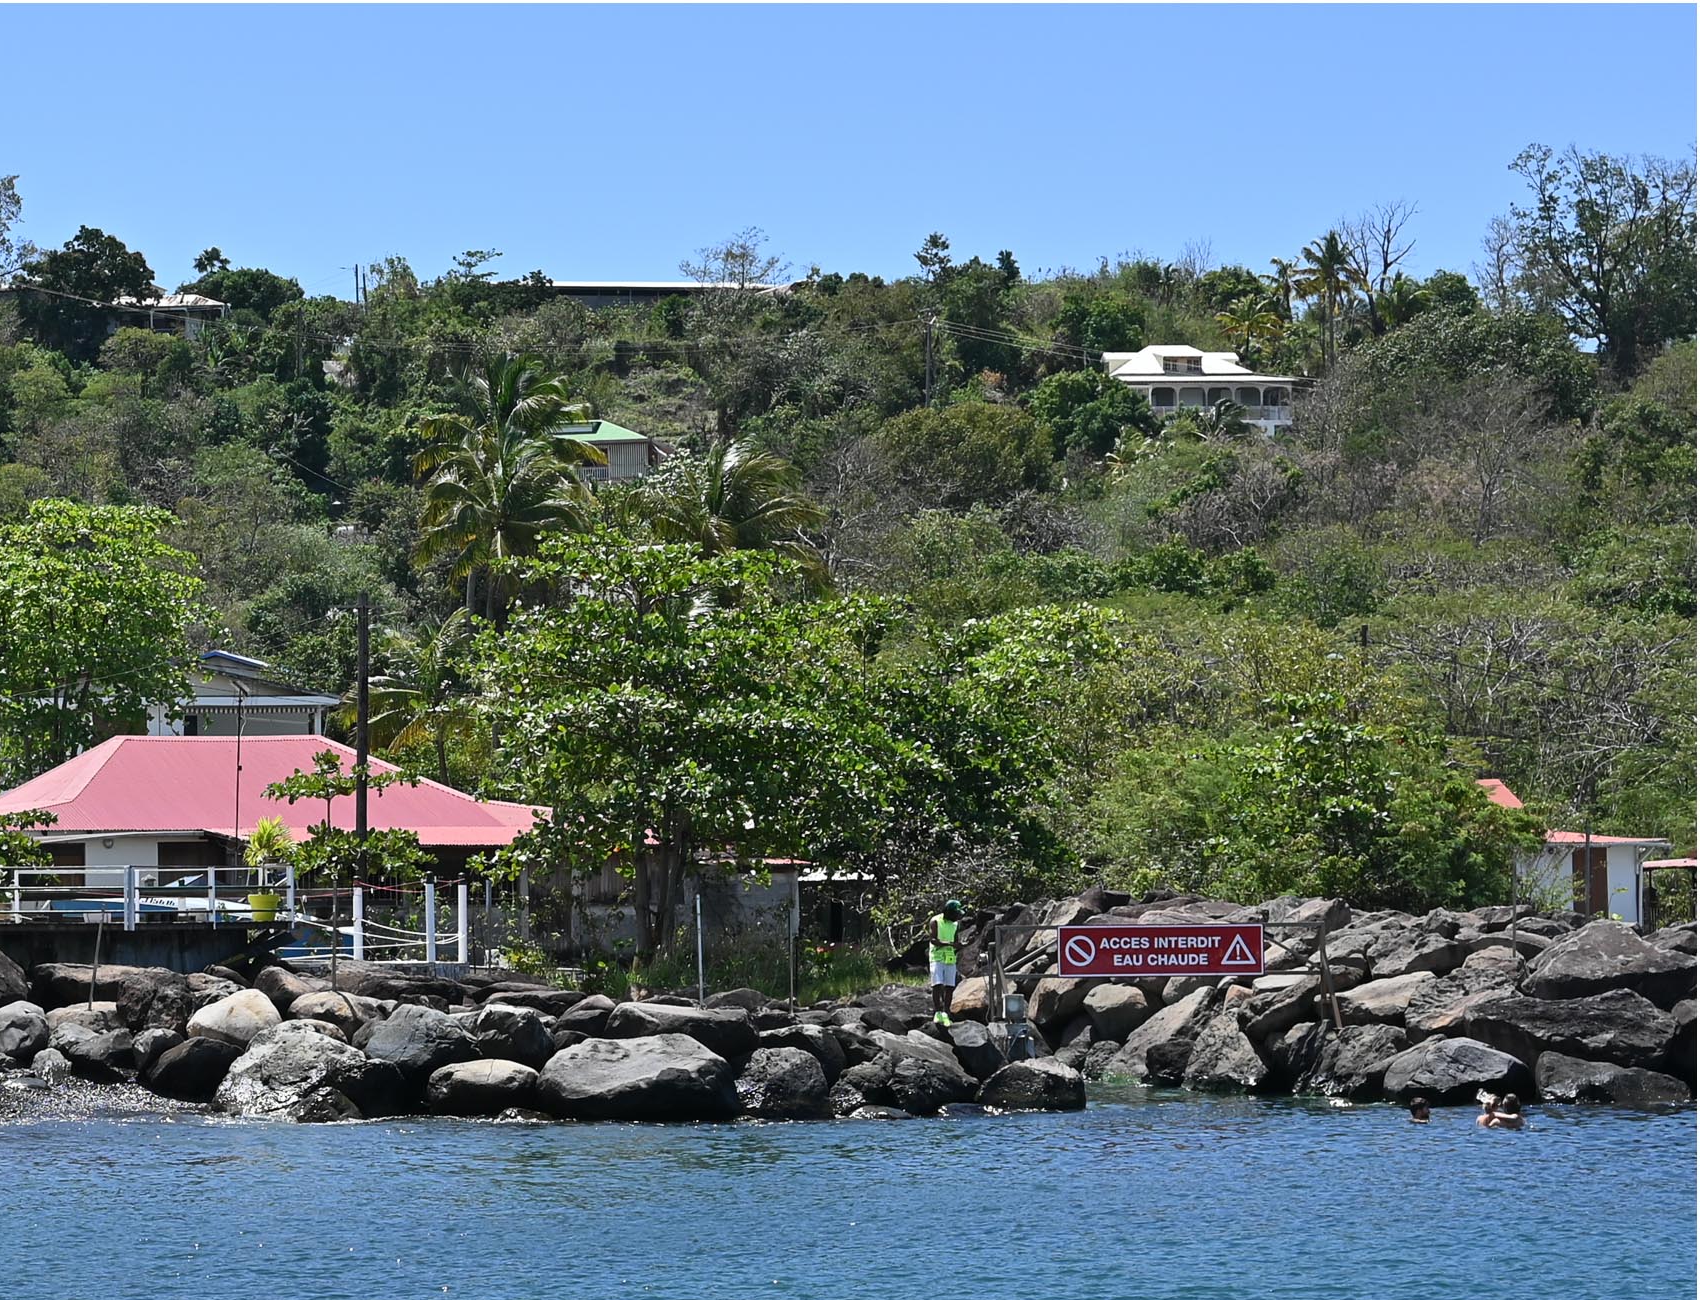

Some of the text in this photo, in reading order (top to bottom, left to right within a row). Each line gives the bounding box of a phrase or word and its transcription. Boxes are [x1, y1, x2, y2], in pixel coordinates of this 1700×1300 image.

[1099, 936, 1222, 949] ACCES INTERDIT
[1113, 953, 1209, 966] EAU CHAUDE
